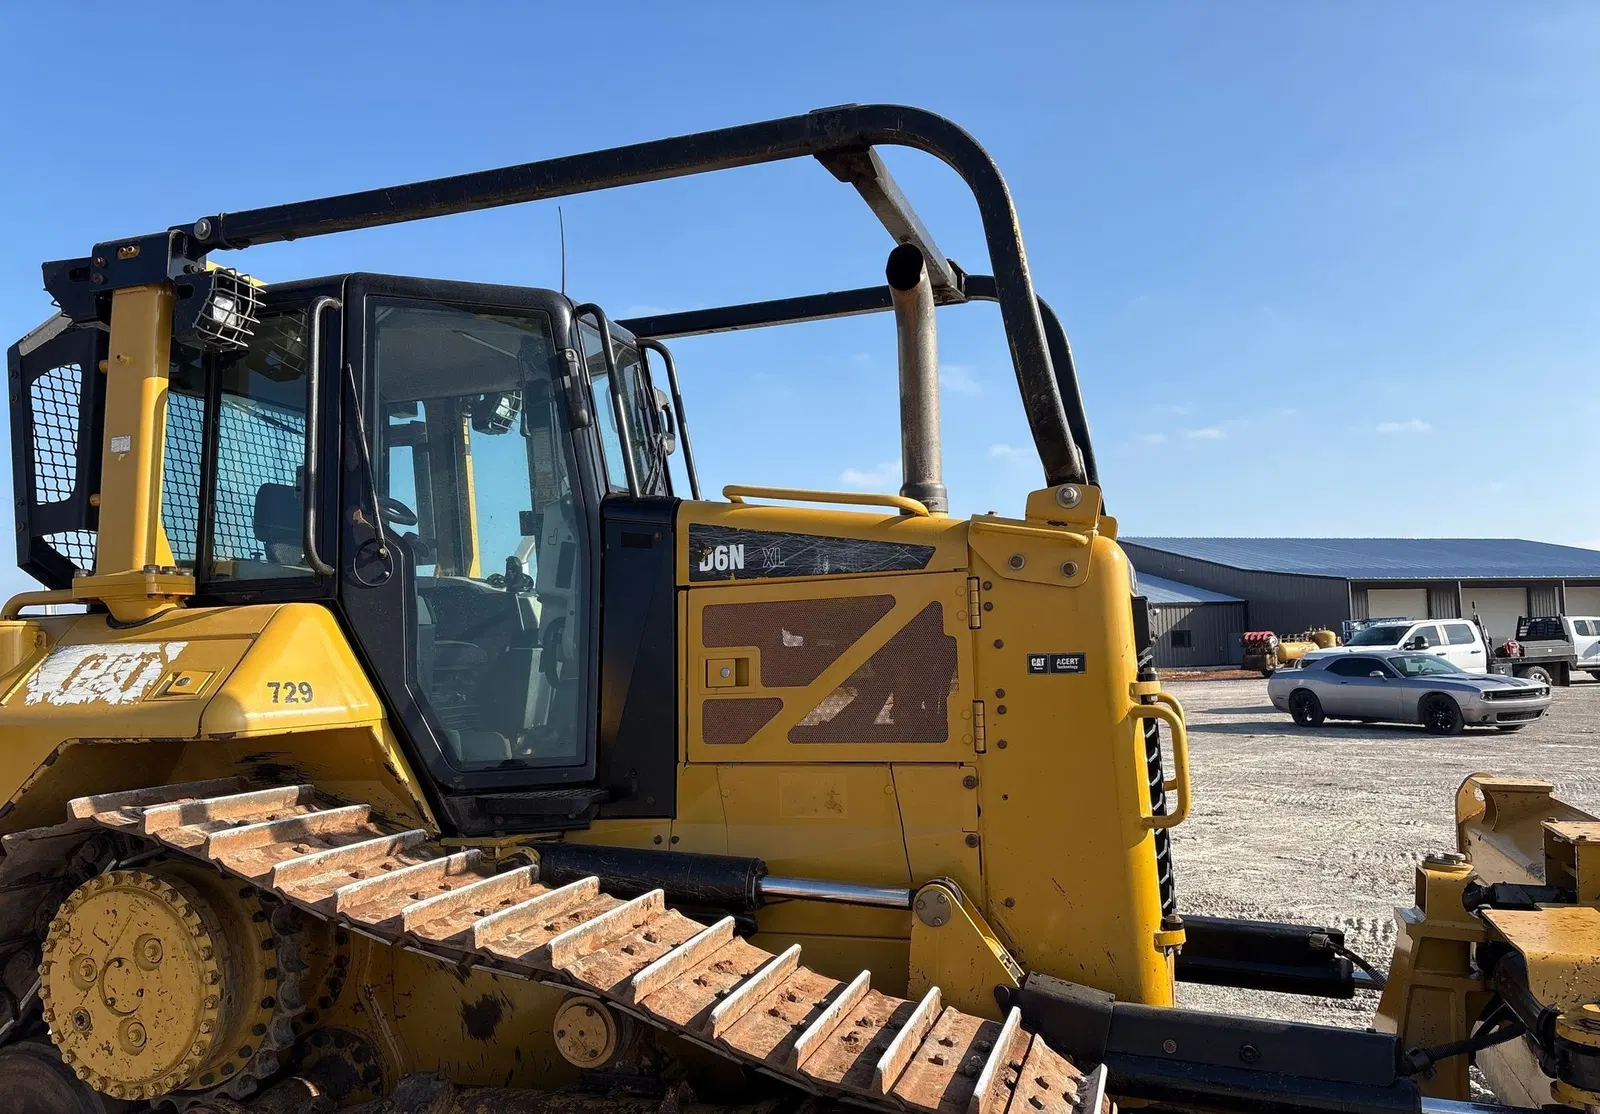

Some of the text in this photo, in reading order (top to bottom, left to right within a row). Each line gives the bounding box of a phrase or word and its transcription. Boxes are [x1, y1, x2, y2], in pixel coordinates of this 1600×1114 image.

[699, 544, 785, 572] D6N XL
[1031, 657, 1045, 667] CAT
[1056, 657, 1080, 665] ACERT
[267, 682, 314, 703] 729
